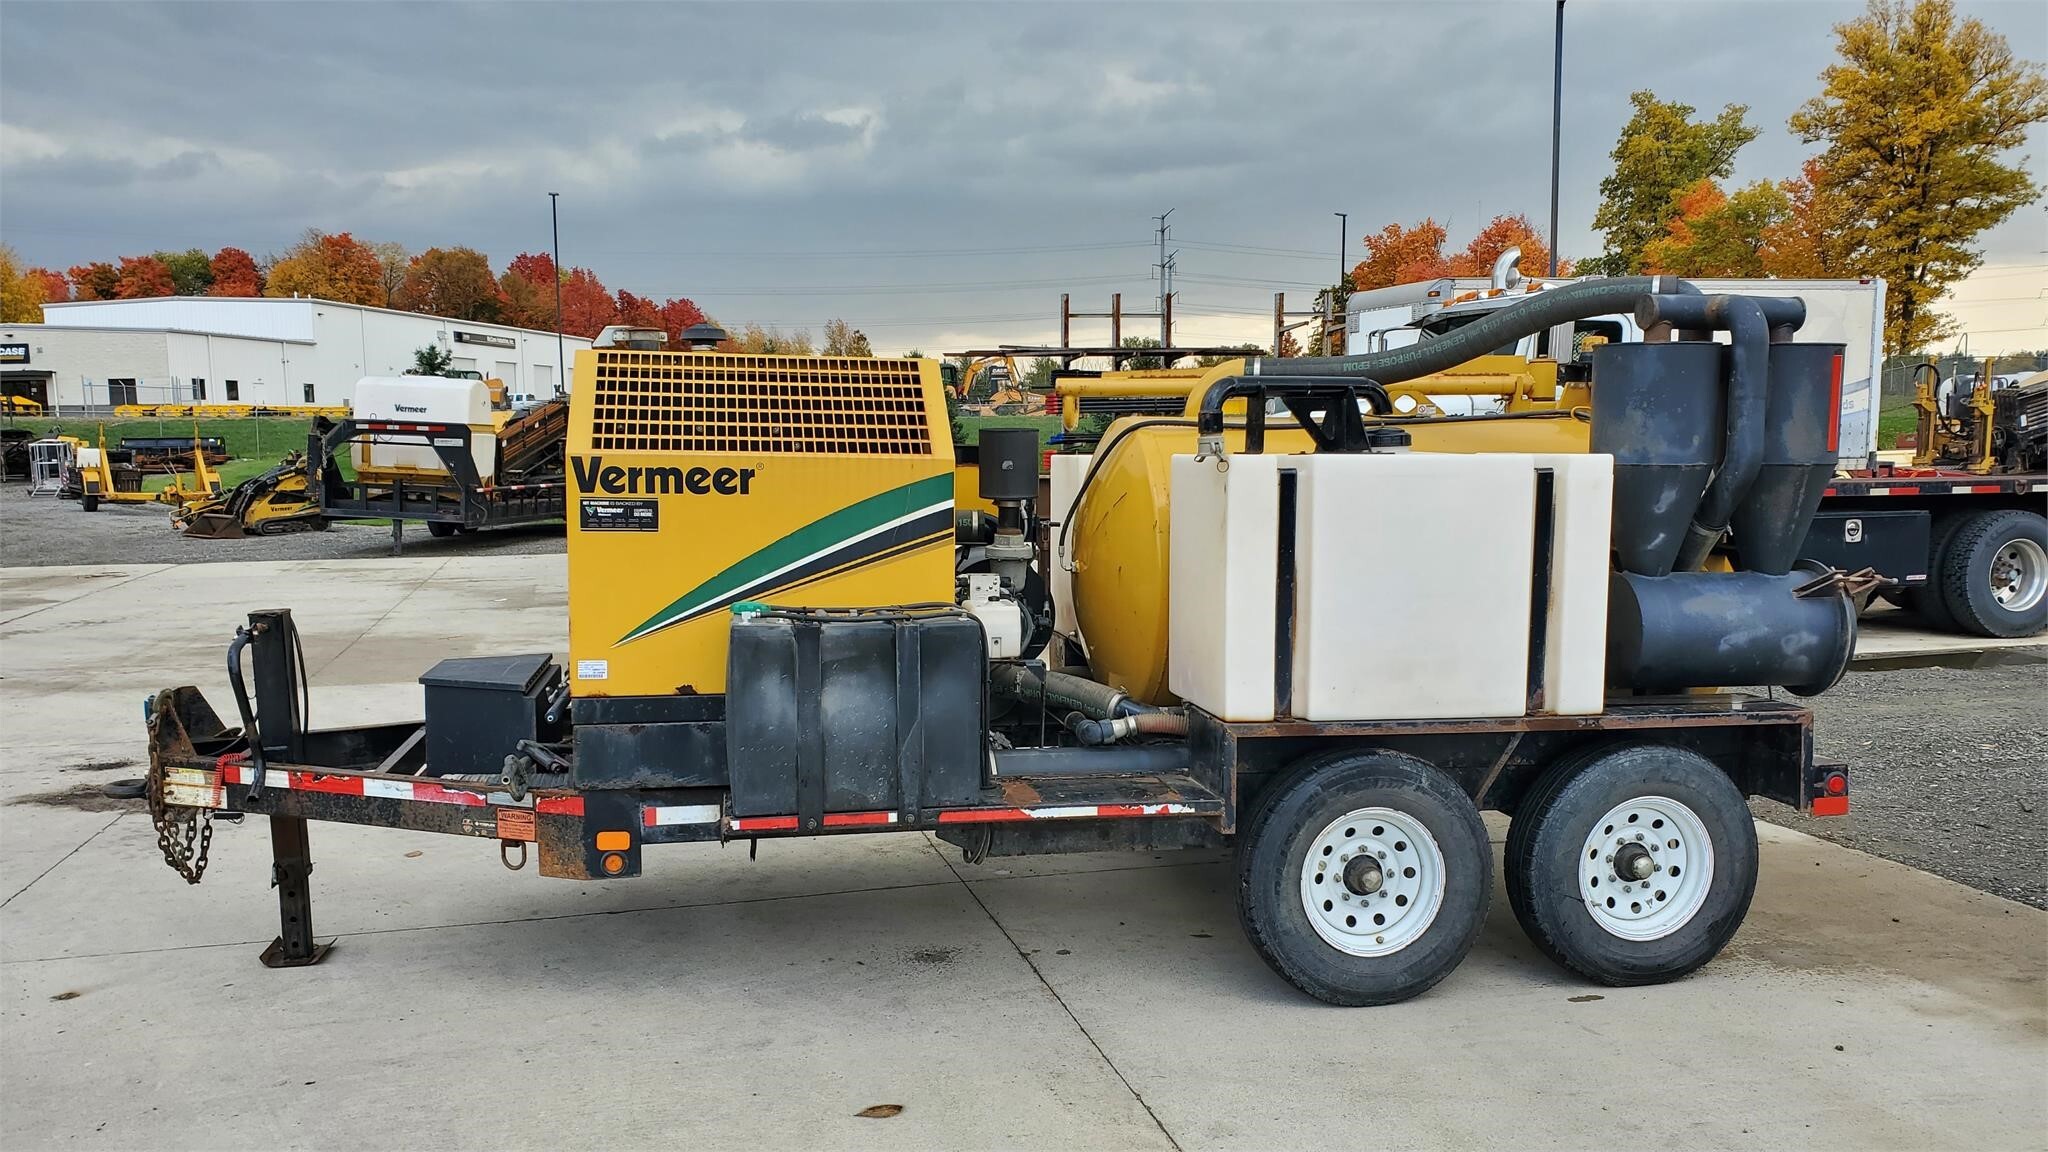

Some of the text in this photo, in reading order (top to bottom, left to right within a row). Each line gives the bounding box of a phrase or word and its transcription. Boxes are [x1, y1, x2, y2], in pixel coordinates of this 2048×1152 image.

[1422, 334, 1465, 355] GENERAL
[0, 347, 26, 356] CASE
[1343, 361, 1371, 371] EPDM
[395, 404, 427, 413] Vermeer
[570, 456, 756, 495] Vermeer
[501, 812, 532, 821] WARNING
